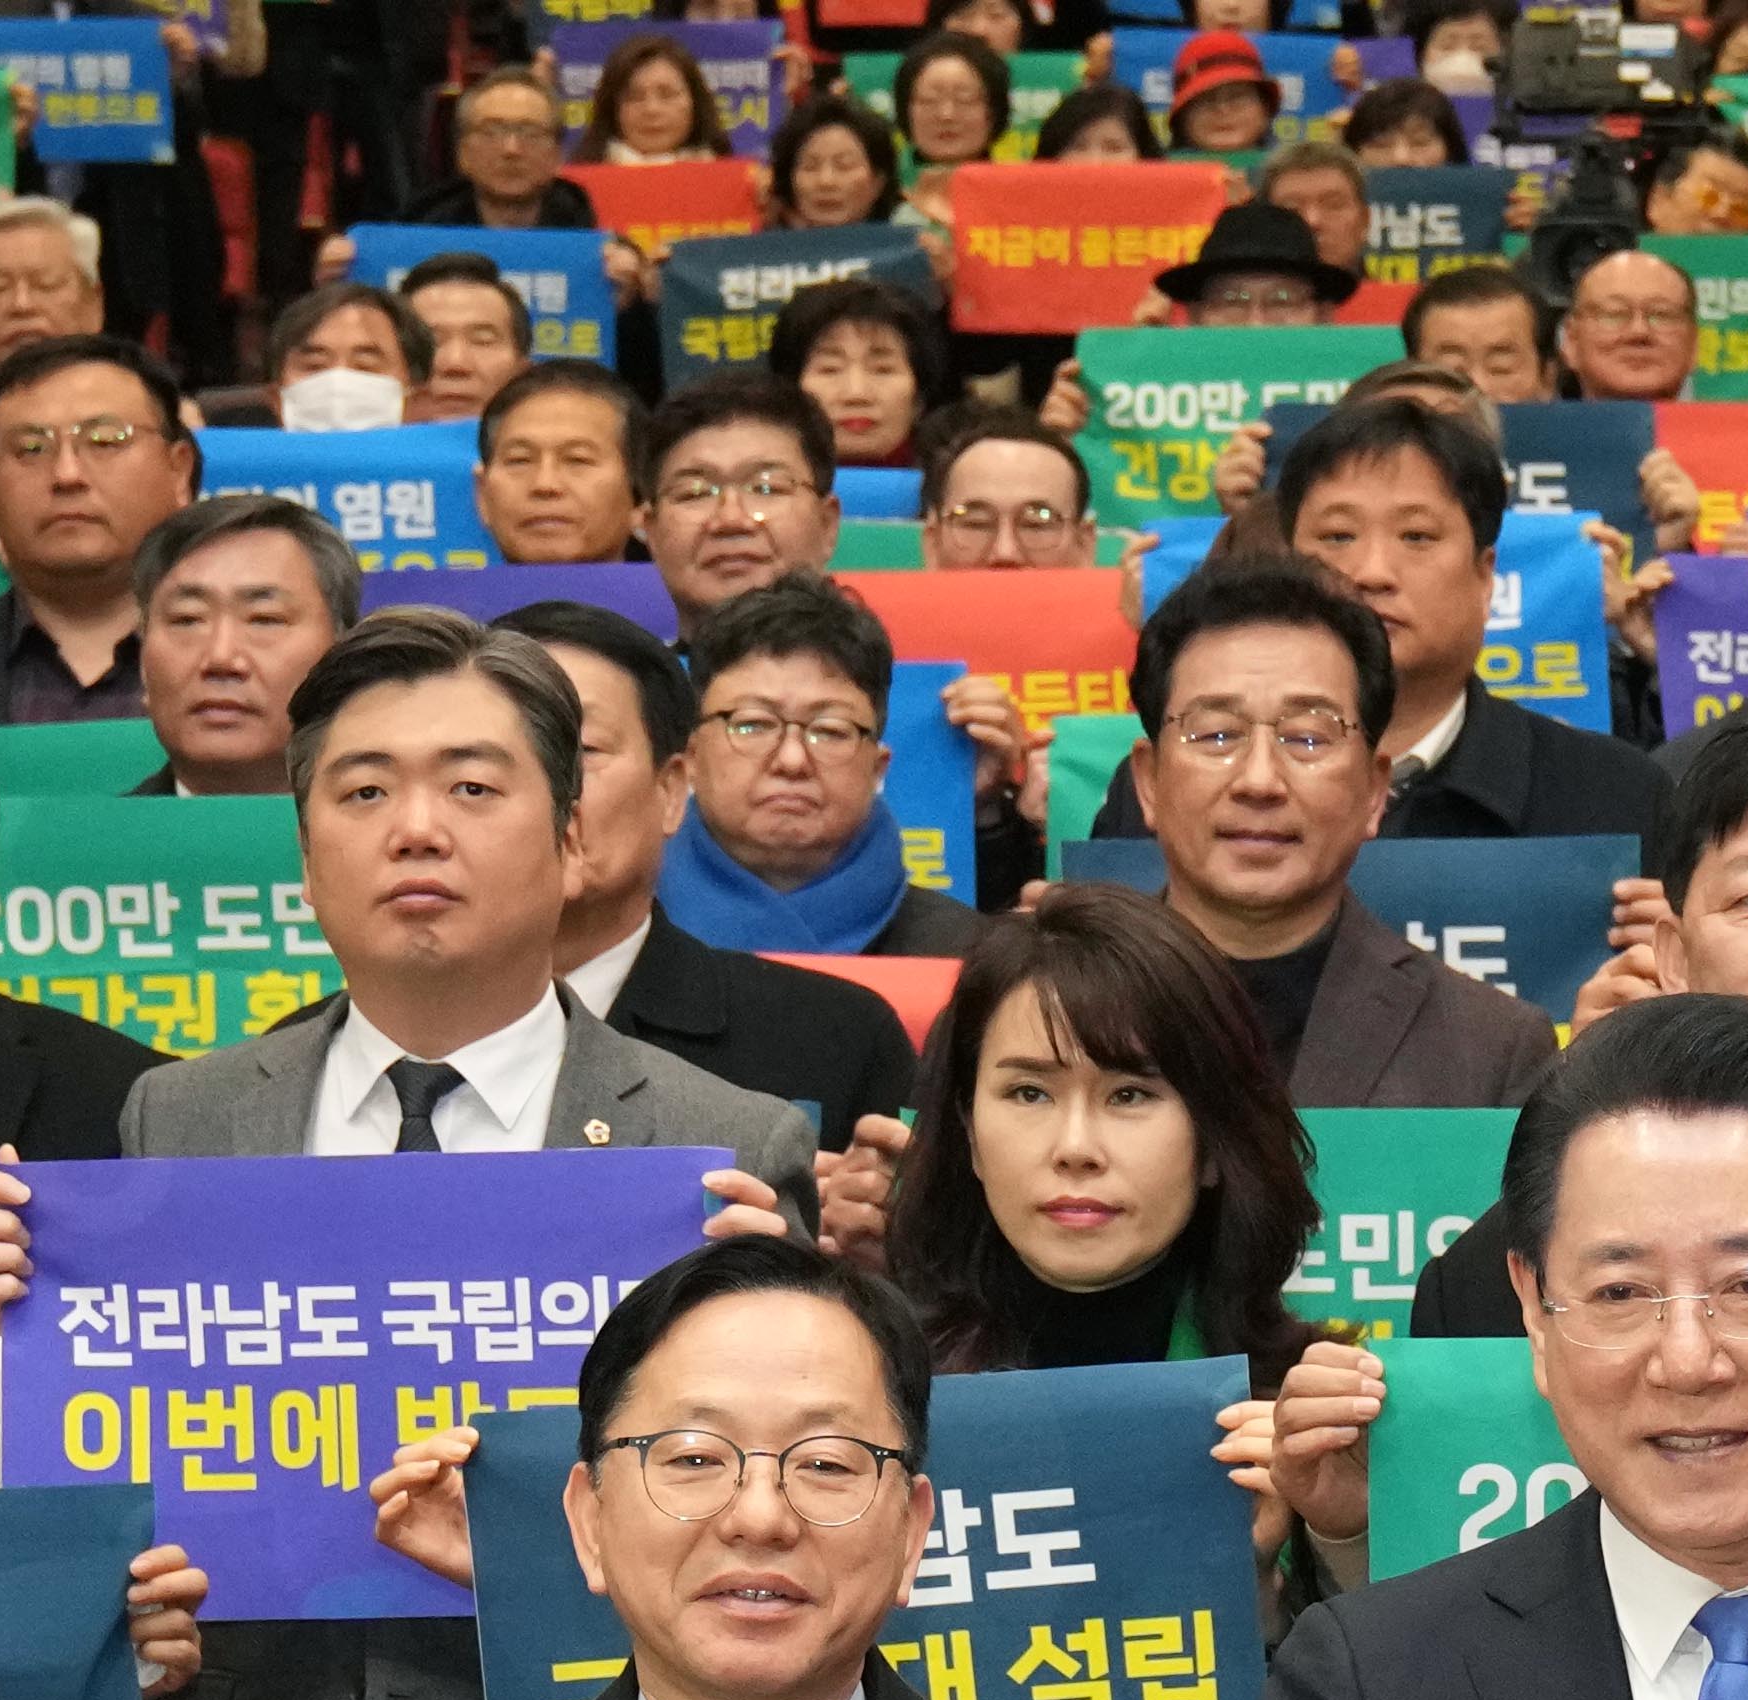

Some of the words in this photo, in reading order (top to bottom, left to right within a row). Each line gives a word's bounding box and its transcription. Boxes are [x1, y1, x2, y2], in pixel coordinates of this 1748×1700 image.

[967, 225, 1069, 268] 지금이
[1103, 381, 1250, 432] 200만
[1112, 440, 1219, 502] 건강
[334, 481, 437, 540] 염원
[1476, 642, 1588, 700] 으로
[58, 1280, 370, 1369] 전라남도
[381, 1274, 634, 1364] 국립의
[63, 1383, 361, 1493] 이번에
[909, 1487, 1097, 1609] 남도
